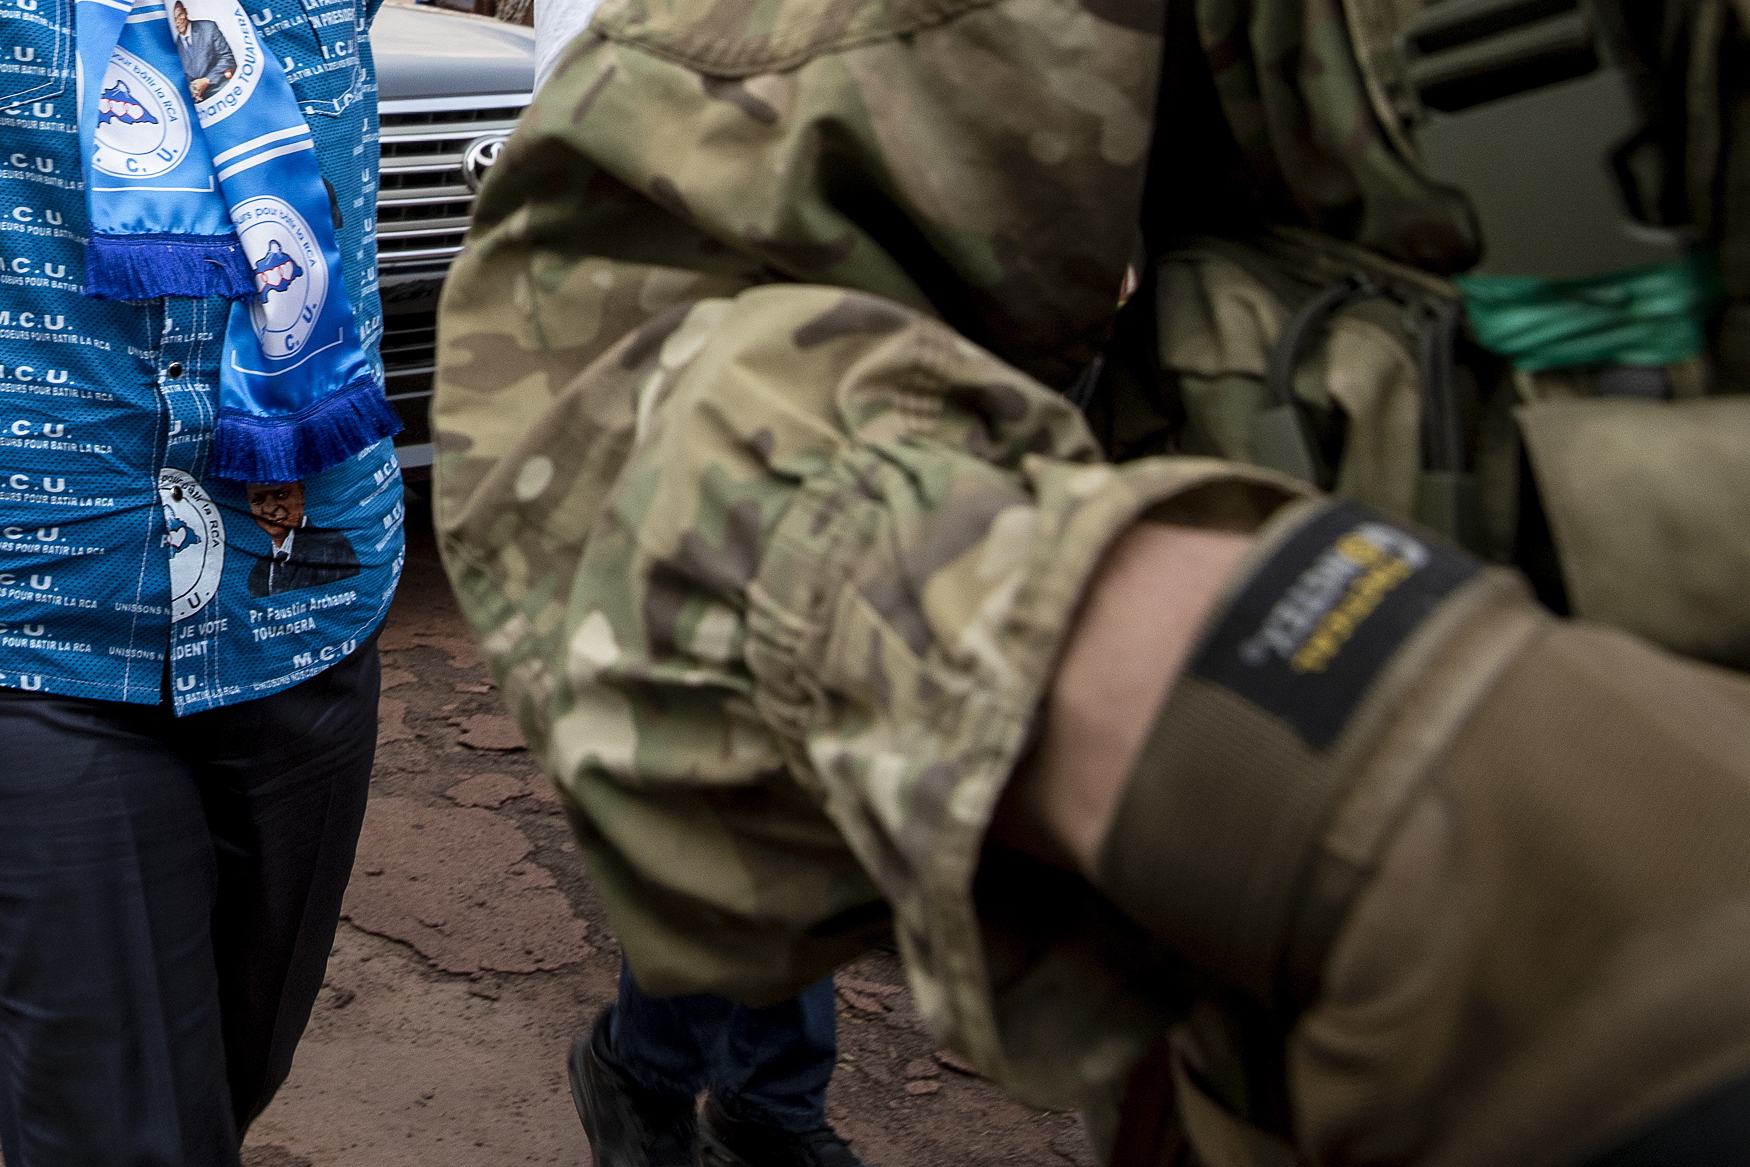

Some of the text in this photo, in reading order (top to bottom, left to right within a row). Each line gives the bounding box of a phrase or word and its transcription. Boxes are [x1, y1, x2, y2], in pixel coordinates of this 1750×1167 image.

[22, 12, 48, 26] BATIR
[264, 20, 292, 36] BATIR
[20, 66, 46, 76] BATIR
[162, 99, 178, 122] RCA
[38, 121, 66, 132] BATIR
[256, 207, 278, 220] pour
[26, 224, 53, 236] POUR
[24, 276, 50, 288] POUR
[51, 280, 78, 292] BATIR
[0, 328, 30, 341] COEURS
[30, 331, 51, 342] POUR
[52, 334, 78, 344] BATIR
[80, 336, 93, 346] LA
[93, 339, 112, 351] RCA
[28, 385, 52, 396] POUR
[52, 388, 79, 398] BATIR
[80, 390, 94, 399] LA
[94, 392, 114, 402] RCA
[24, 438, 50, 450] POUR
[50, 441, 79, 452] BATIR
[80, 444, 92, 453] LA
[94, 444, 113, 454] RCA
[23, 493, 48, 504] POUR
[50, 496, 78, 506] BATIR
[80, 498, 92, 506] LA
[94, 498, 114, 507] RCA
[208, 518, 220, 549] RCA
[14, 542, 41, 553] POUR
[42, 544, 70, 556] BATIR
[70, 546, 84, 556] LA
[8, 589, 34, 602] POUR
[34, 593, 62, 606] BATIR
[63, 596, 76, 608] LA
[78, 599, 98, 609] RCA
[250, 590, 358, 624] Pr Faustin Archange
[114, 602, 159, 615] UNISSONS
[180, 618, 229, 639] JE VOTE
[252, 617, 316, 642] TOUADERA
[2, 636, 29, 648] POUR
[29, 639, 57, 650] BATIR
[58, 641, 71, 651] LA
[72, 642, 92, 653] RCA
[108, 646, 150, 660] UNISSONS
